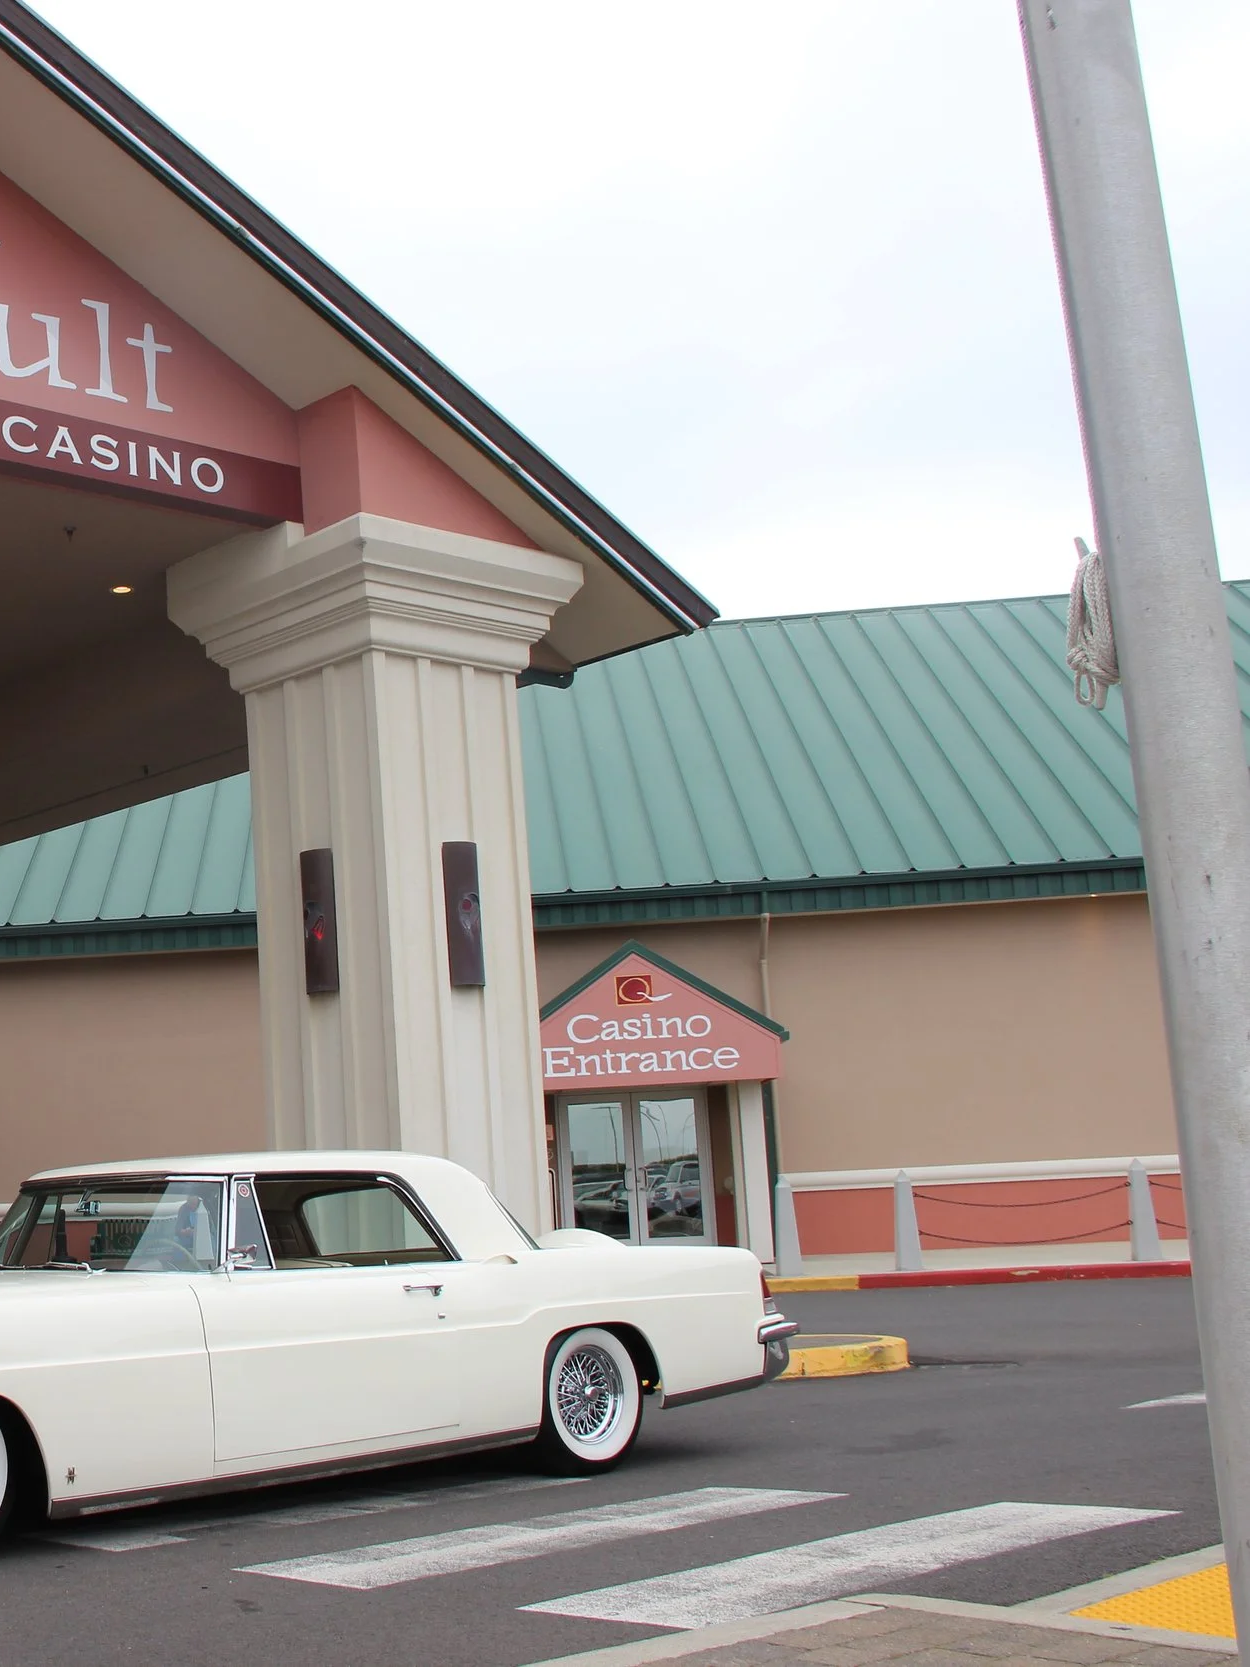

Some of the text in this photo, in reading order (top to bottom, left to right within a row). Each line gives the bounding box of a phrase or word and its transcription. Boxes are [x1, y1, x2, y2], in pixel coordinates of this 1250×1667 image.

[1, 416, 225, 493] CASINO
[619, 977, 672, 1002] Q
[566, 1013, 712, 1044] Casino
[543, 1047, 740, 1078] Entrance
